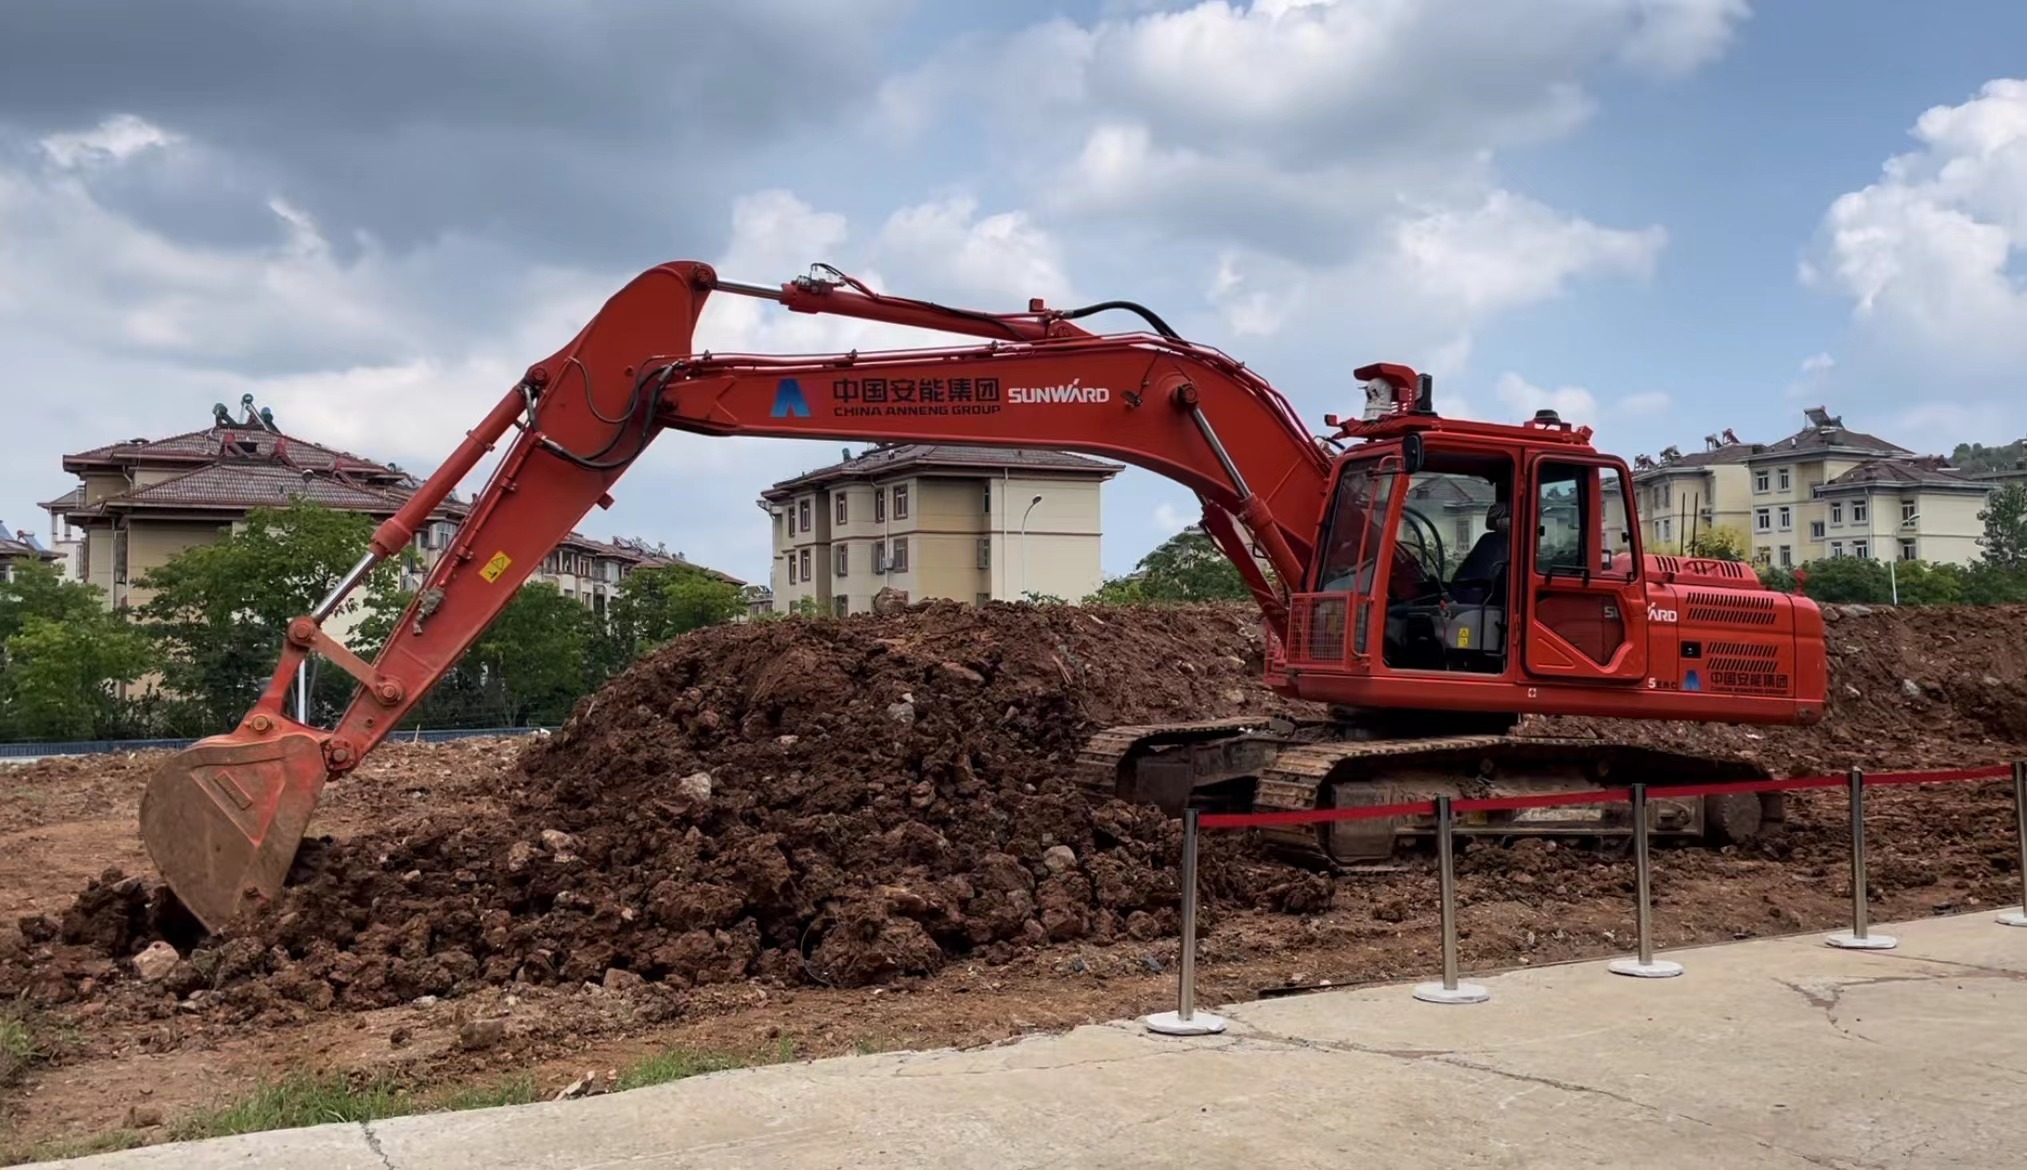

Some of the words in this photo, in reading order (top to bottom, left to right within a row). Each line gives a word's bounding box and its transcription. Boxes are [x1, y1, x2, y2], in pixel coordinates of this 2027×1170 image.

[833, 378, 999, 403] 中国安能集团
[1008, 378, 1110, 403] SUNWARD
[834, 406, 881, 417] CHINA
[885, 405, 948, 416] ANNENG
[952, 405, 1000, 415] GROUP
